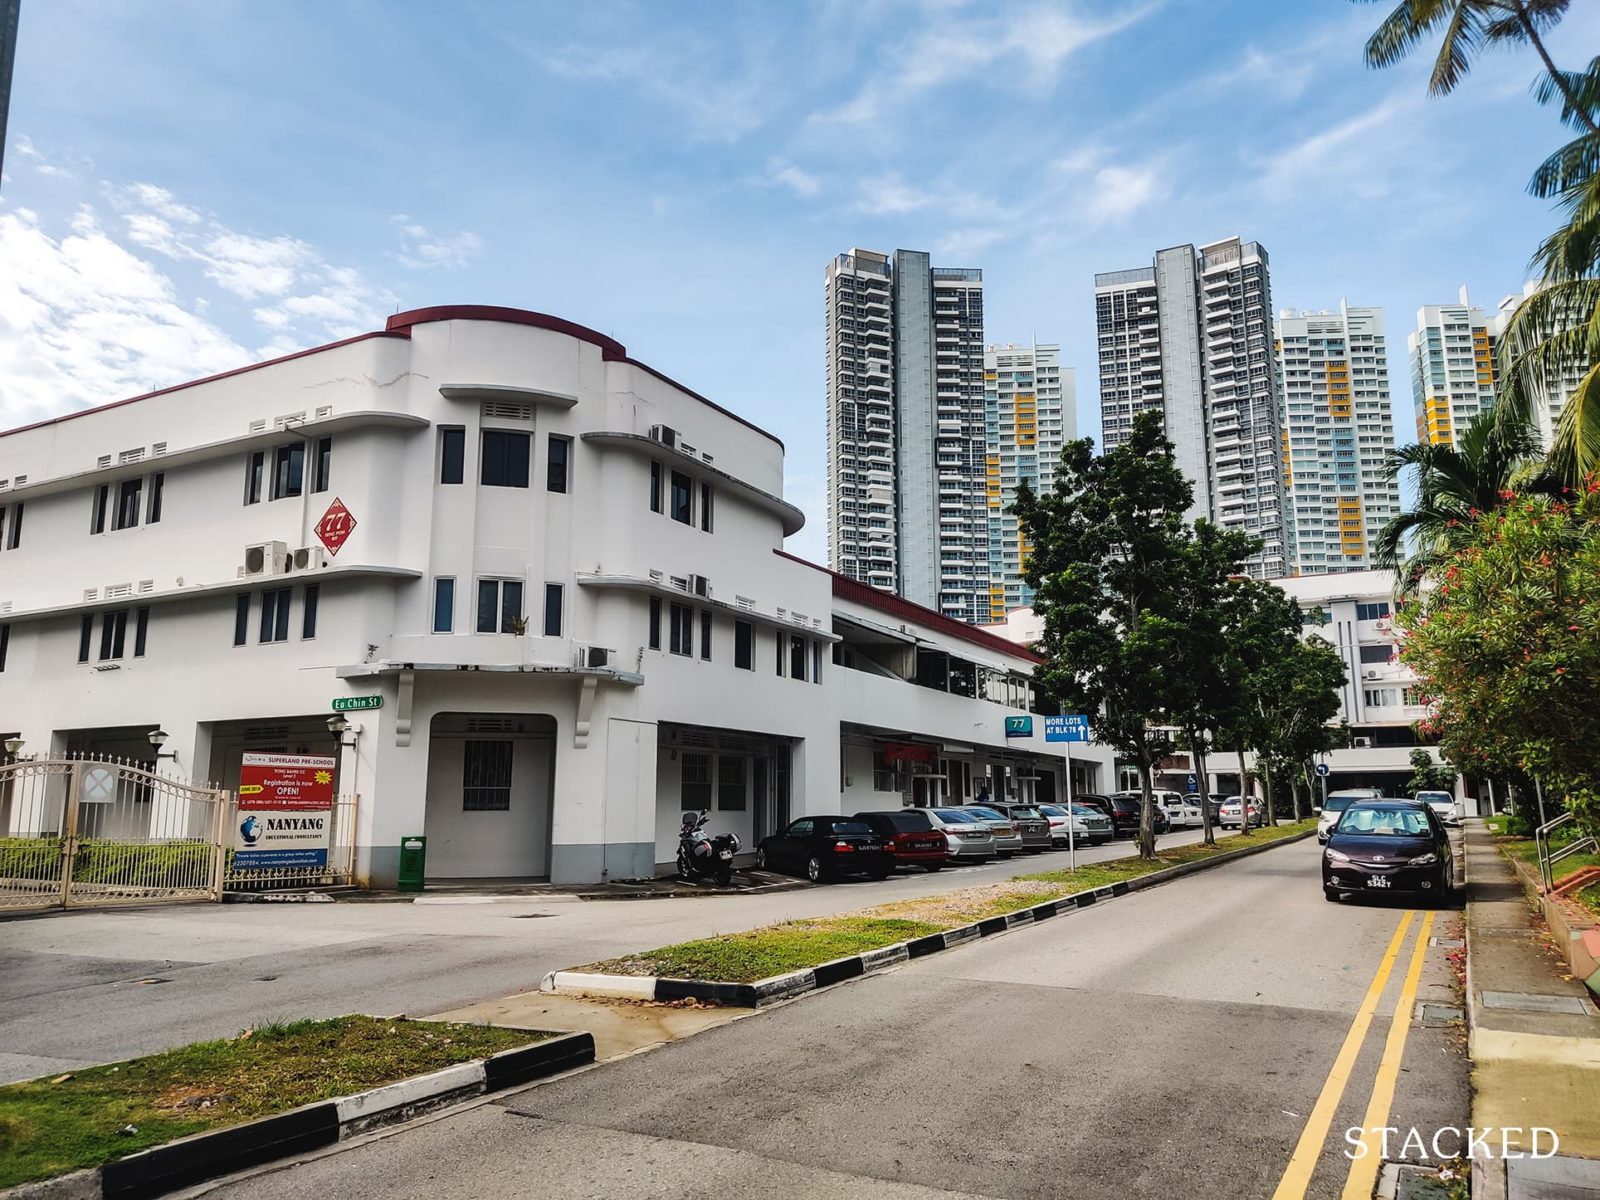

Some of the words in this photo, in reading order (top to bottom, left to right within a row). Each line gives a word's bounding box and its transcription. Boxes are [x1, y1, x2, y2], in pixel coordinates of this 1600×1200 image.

[325, 512, 347, 531] 77
[335, 700, 344, 708] Eu
[348, 698, 365, 708] Chin
[369, 697, 377, 706] St
[1012, 719, 1025, 728] 77
[1055, 726, 1067, 734] BLK
[301, 758, 334, 766] PRE-SCHOOL
[277, 787, 298, 795] OPEN!
[266, 819, 323, 830] NANYANG
